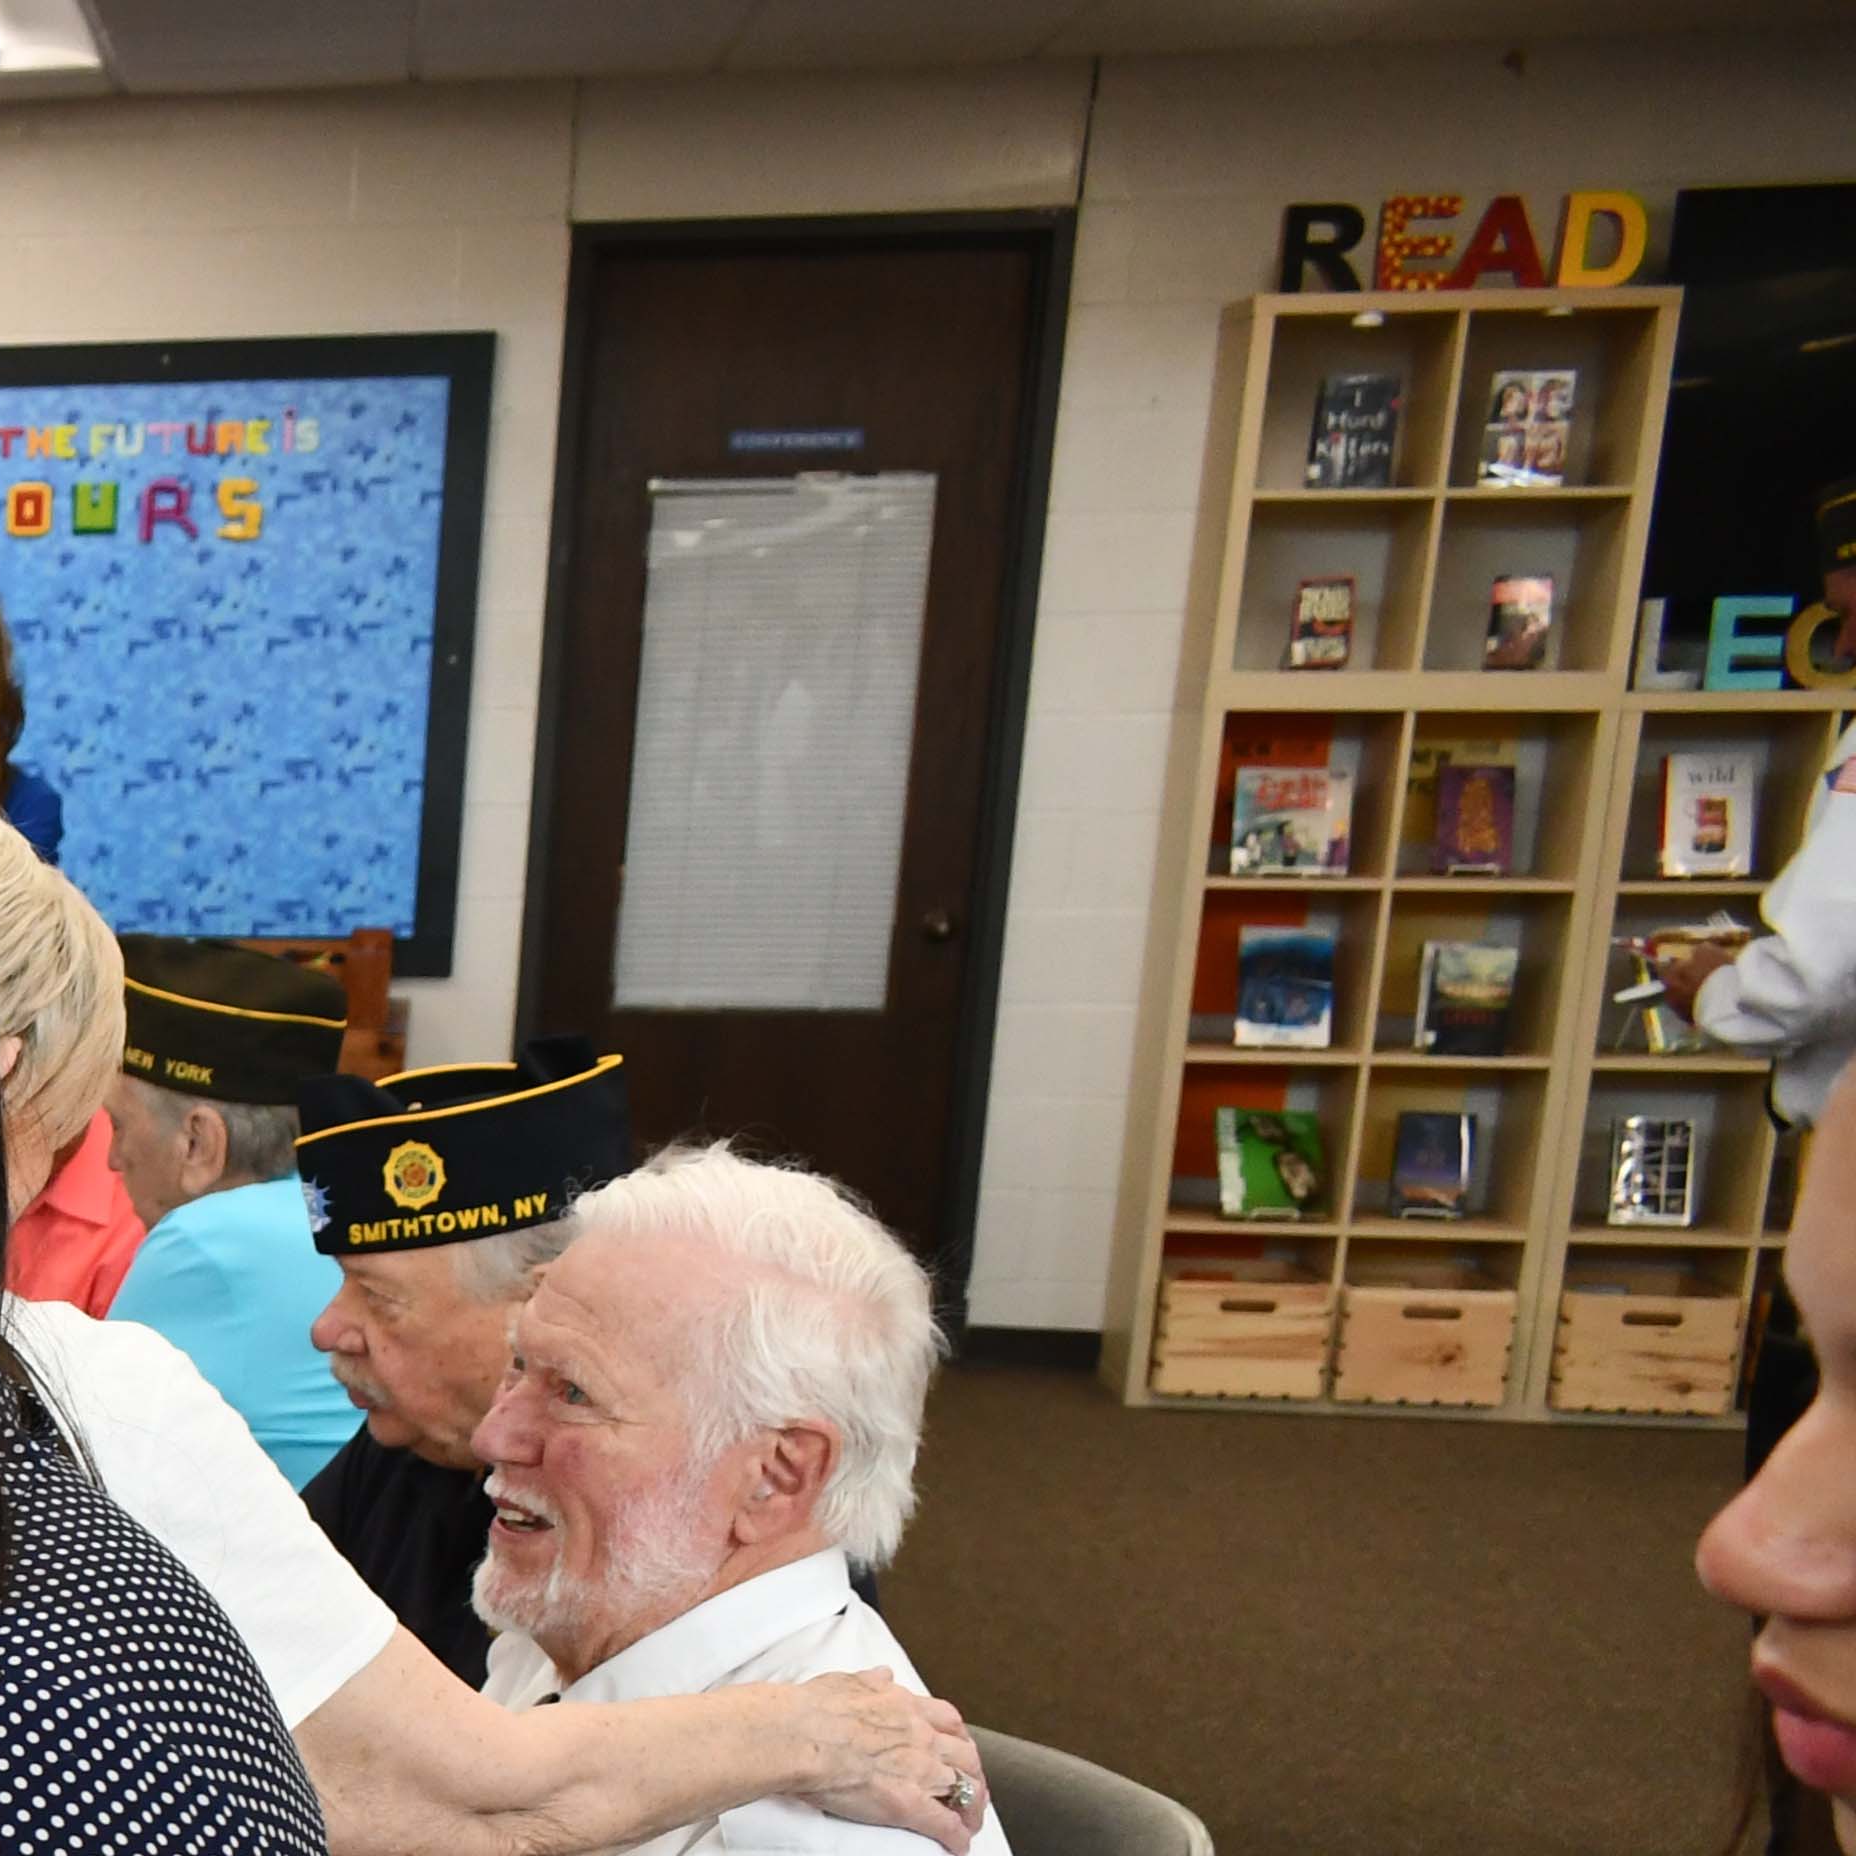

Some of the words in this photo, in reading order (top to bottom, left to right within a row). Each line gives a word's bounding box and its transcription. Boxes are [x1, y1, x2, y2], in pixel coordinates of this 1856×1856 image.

[1279, 191, 1647, 293] READ
[91, 418, 271, 456] FUTURE
[5, 477, 265, 544] OURS
[165, 1056, 215, 1085] YORK
[348, 1203, 507, 1245] SMITHTOWN,
[514, 1192, 548, 1220] NY
